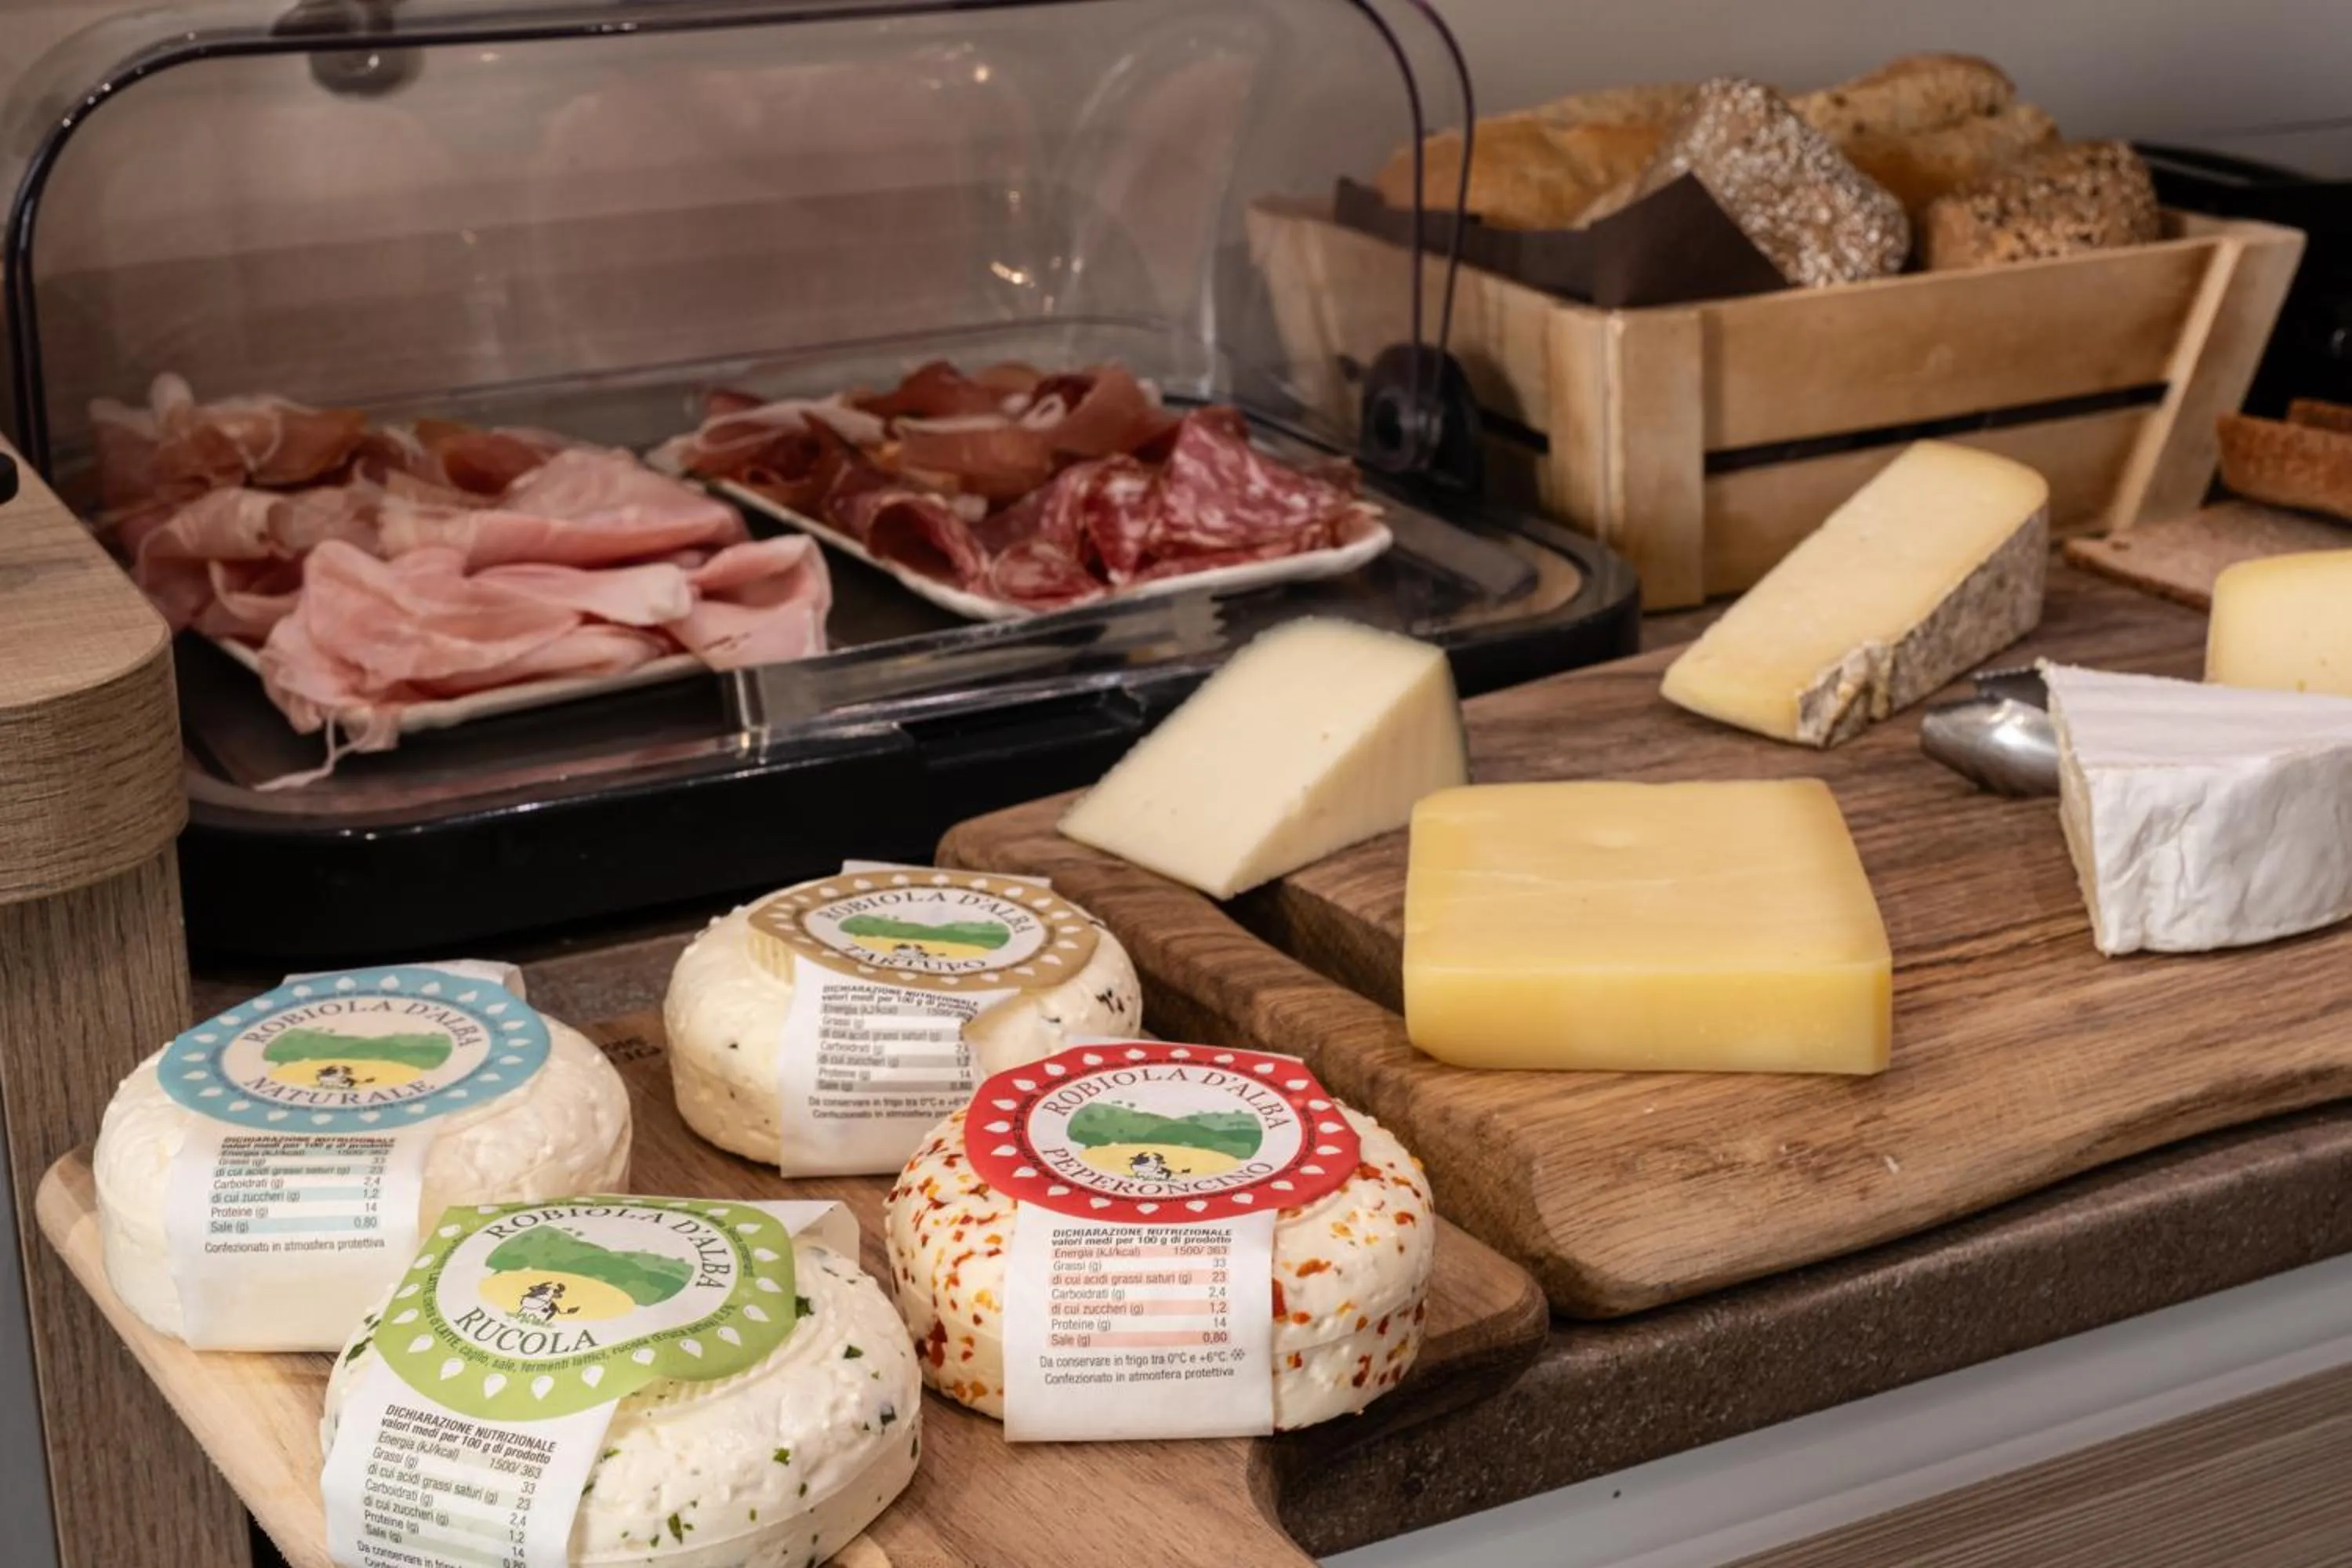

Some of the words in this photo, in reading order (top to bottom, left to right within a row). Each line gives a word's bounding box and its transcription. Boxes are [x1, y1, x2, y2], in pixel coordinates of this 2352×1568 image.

[818, 891, 946, 922] ROBIOLA
[958, 895, 1034, 935] D'ALBA
[844, 944, 987, 971] TARTUFO
[241, 1000, 391, 1045] ROBIOLA
[405, 1003, 483, 1047] D'ALBA
[243, 1076, 434, 1105] NATURALE
[1042, 1068, 1189, 1117] ROBIOLA
[1200, 1071, 1290, 1130] D'ALBA
[1042, 1147, 1274, 1194] PEPERONCINO
[213, 1178, 267, 1189] Carboidrati
[270, 1178, 284, 1189] (g)
[363, 1177, 380, 1187] 2,4
[211, 1192, 221, 1203] di
[224, 1192, 239, 1203] cui
[242, 1190, 284, 1203] zuccheri
[286, 1190, 300, 1203] (g)
[363, 1188, 379, 1199] 1,2
[211, 1207, 252, 1218] Proteine
[255, 1207, 269, 1218] (g)
[365, 1202, 376, 1212] 14
[211, 1221, 233, 1233] Sale
[235, 1220, 249, 1233] (g)
[354, 1216, 377, 1229] 0,80
[1053, 1228, 1142, 1238] DICHIARAZIONE
[1147, 1228, 1232, 1236] NUTRIZIONALE
[205, 1241, 269, 1253] Confezionato
[272, 1241, 281, 1252] in
[284, 1239, 335, 1252] atmosfera
[337, 1239, 385, 1251] protettiva
[483, 1208, 664, 1240] ROBIOLA
[670, 1219, 731, 1289] D'ALBA
[1051, 1237, 1082, 1246] valori
[1116, 1237, 1134, 1246] per
[1160, 1237, 1167, 1246] g
[1054, 1247, 1093, 1258] Energia
[1053, 1260, 1085, 1270] Grassi
[1088, 1260, 1102, 1272] (g)
[1213, 1258, 1225, 1268] 33
[1053, 1274, 1062, 1284] di
[1065, 1274, 1080, 1284] cui
[1083, 1274, 1108, 1284] acidi
[1111, 1274, 1142, 1285] grassi
[1146, 1272, 1175, 1284] saturi
[1178, 1272, 1192, 1285] (g)
[1212, 1271, 1225, 1283] 23
[1051, 1288, 1109, 1300] Carboidrati
[1111, 1288, 1125, 1301] (g)
[1208, 1287, 1226, 1298] 2,4
[1051, 1303, 1061, 1315] di
[1064, 1303, 1080, 1315] cui
[1083, 1303, 1127, 1315] zuccheri
[1130, 1304, 1144, 1316] (g)
[1210, 1301, 1227, 1314] 1,2
[454, 1306, 598, 1356] RUCOLA
[1051, 1319, 1094, 1330] Proteine
[1097, 1319, 1111, 1331] (g)
[1214, 1317, 1226, 1327] 14
[1051, 1334, 1075, 1346] Sale
[1077, 1334, 1091, 1348] (g)
[1203, 1331, 1227, 1344] 0,80
[1040, 1356, 1054, 1367] Da
[1056, 1356, 1111, 1367] conservare
[1112, 1355, 1123, 1366] in
[1125, 1354, 1149, 1368] frigo
[1151, 1353, 1165, 1364] tra
[1189, 1355, 1196, 1363] e
[1045, 1372, 1112, 1385] Confezionato
[1116, 1372, 1125, 1382] in
[1129, 1370, 1181, 1382] atmosfera
[1185, 1367, 1234, 1381] protettiva
[385, 1404, 474, 1435] DICHIARAZIONE
[474, 1427, 557, 1453] NUTRIZIONALE
[381, 1417, 412, 1432] valori
[412, 1425, 440, 1438] medi
[438, 1432, 459, 1443] per
[462, 1436, 482, 1450] 100
[481, 1443, 491, 1454] g
[492, 1443, 504, 1454] di
[503, 1446, 551, 1465] prodotto
[379, 1431, 415, 1450] Energia
[521, 1465, 543, 1479] 363
[372, 1446, 404, 1463] Grassi
[405, 1454, 419, 1468] (g)
[521, 1481, 536, 1494] 33
[368, 1464, 378, 1475] di
[379, 1467, 395, 1479] cui
[396, 1471, 421, 1485] acidi
[421, 1477, 452, 1493] grassi
[454, 1483, 482, 1500] saturi
[484, 1490, 498, 1505] (g)
[517, 1497, 531, 1511] 23
[365, 1478, 418, 1501] Carboidrati
[420, 1491, 434, 1507] (g)
[510, 1512, 527, 1527] 2,4
[393, 1502, 434, 1522] zuccheri
[435, 1510, 449, 1527] (g)
[365, 1508, 404, 1530] Proteine
[406, 1520, 419, 1534] (g)
[512, 1545, 524, 1558] 14
[365, 1523, 387, 1539] Sale
[389, 1530, 402, 1544] (g)
[357, 1540, 371, 1553] Da
